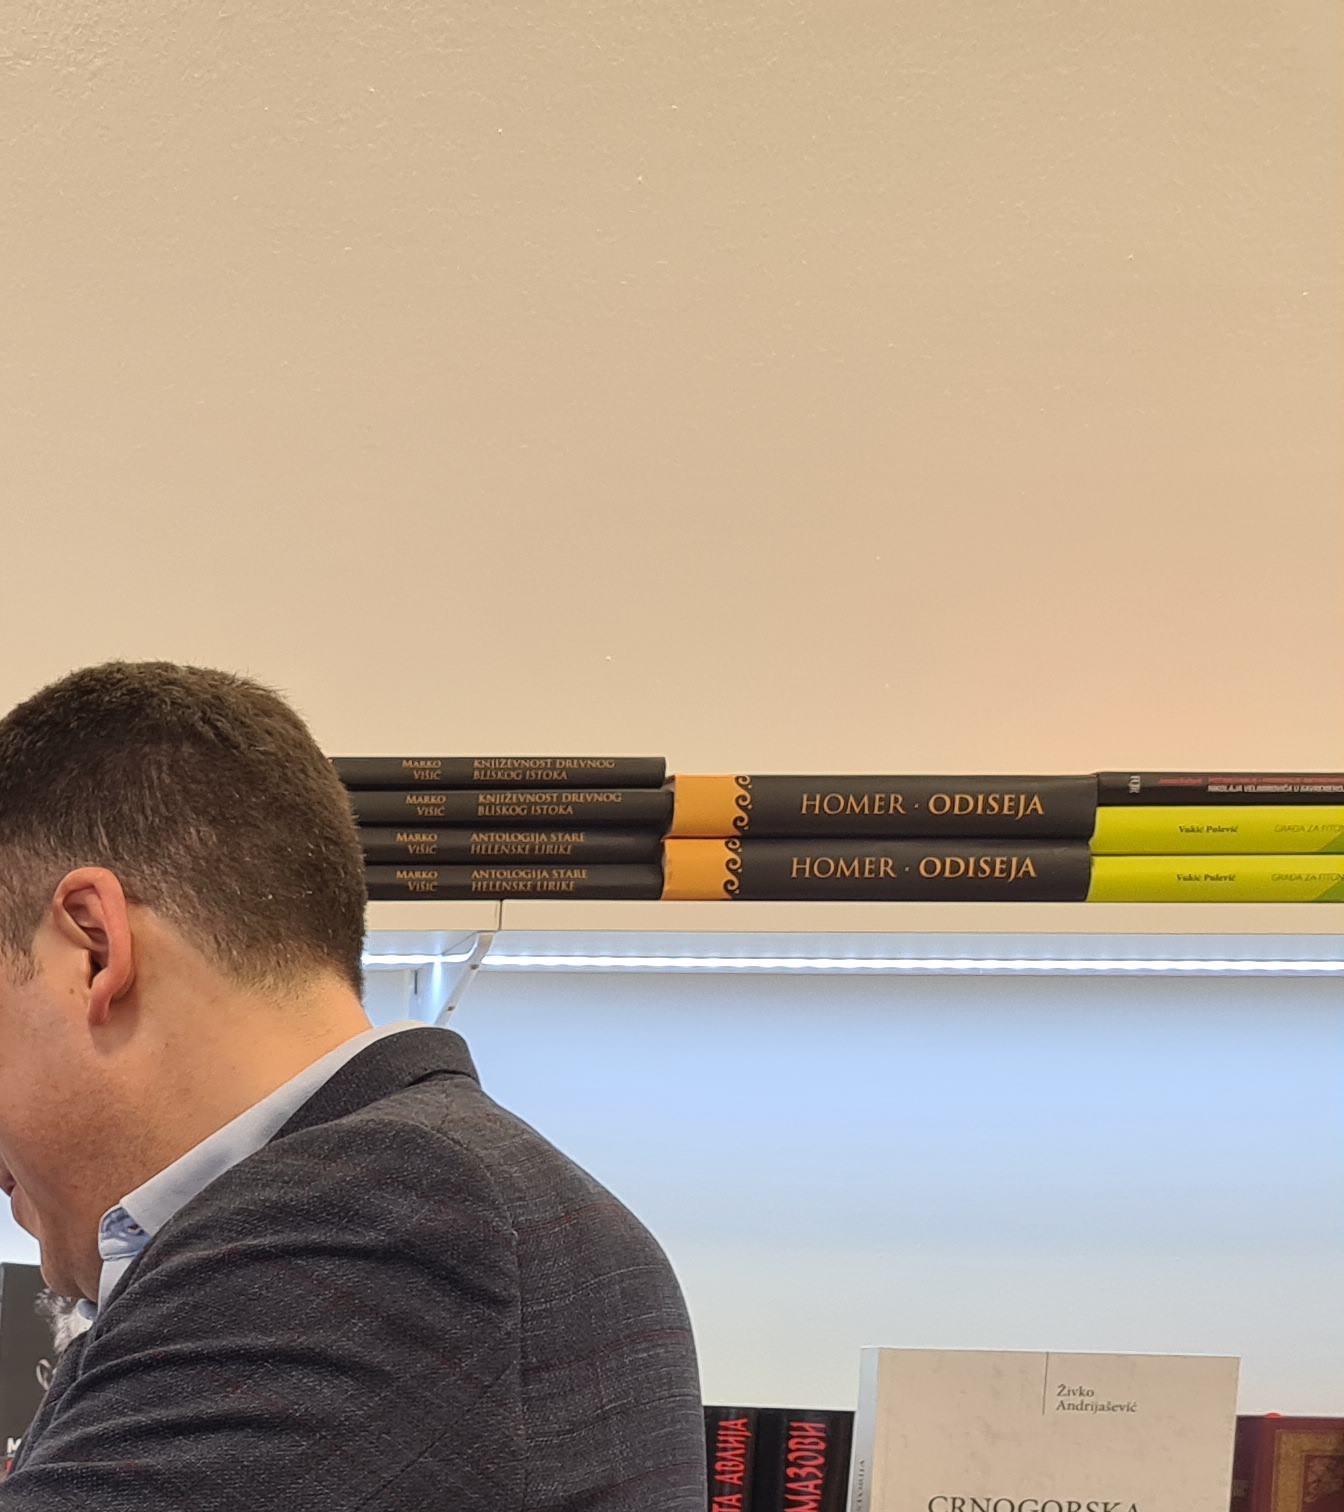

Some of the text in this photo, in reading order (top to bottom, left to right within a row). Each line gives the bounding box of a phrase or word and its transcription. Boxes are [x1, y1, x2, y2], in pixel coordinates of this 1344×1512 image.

[402, 758, 441, 768] MARKO
[473, 758, 615, 768] KNJIŽEVNOST DREVNOG
[473, 769, 568, 780] BLISKOG ISTOKA
[406, 794, 446, 804] MARKO
[478, 792, 622, 804] KNJIŽEVNOST DREVNOG
[477, 804, 573, 816] BLISKOG ISTOKA
[800, 793, 1045, 821] HOMER ODISEJA
[396, 832, 438, 843] MARKO
[470, 832, 586, 844] ANTOLOGIJA STARE
[470, 844, 573, 855] HELENSKE LIRIKE
[396, 869, 438, 880] MARKO
[471, 869, 588, 881] ANTOLOGIJA STARE
[790, 856, 1038, 884] HOMER ODISEJA
[471, 880, 575, 892] HELENSKE LIRIKE
[1057, 1383, 1095, 1397] Živko
[1055, 1400, 1138, 1415] Andrijašević
[714, 1417, 753, 1486] АВЛИЈА
